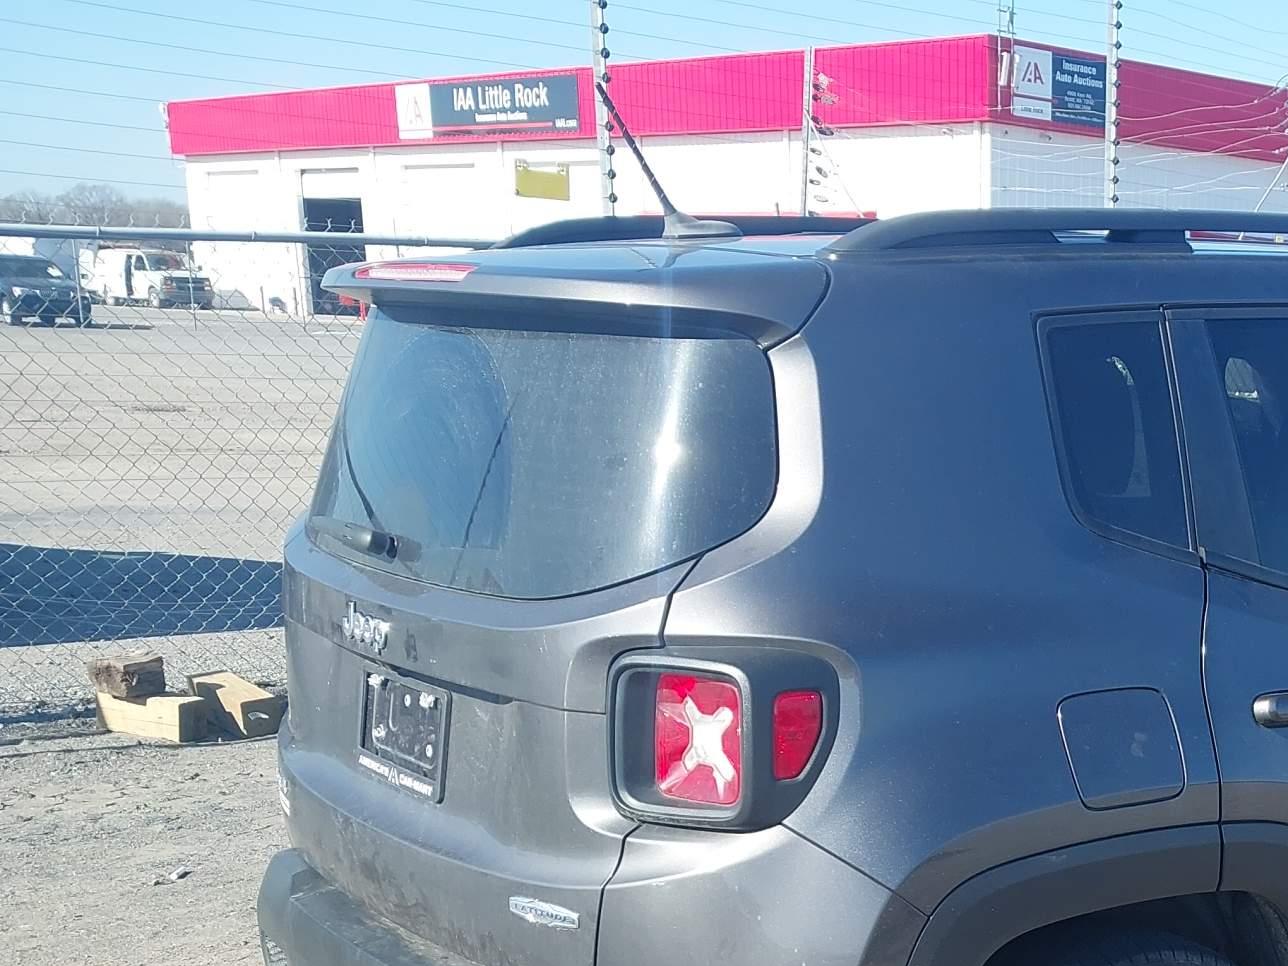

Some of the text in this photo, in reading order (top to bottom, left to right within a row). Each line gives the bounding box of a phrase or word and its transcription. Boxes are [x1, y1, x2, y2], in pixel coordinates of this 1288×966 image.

[1062, 59, 1097, 75] Insurance
[1055, 70, 1104, 88] Auto Auctions
[453, 87, 475, 111] IAA
[477, 84, 511, 110] Little
[515, 82, 549, 108] Rock
[342, 600, 391, 653] Jeep
[514, 903, 576, 924] LATITUDE
